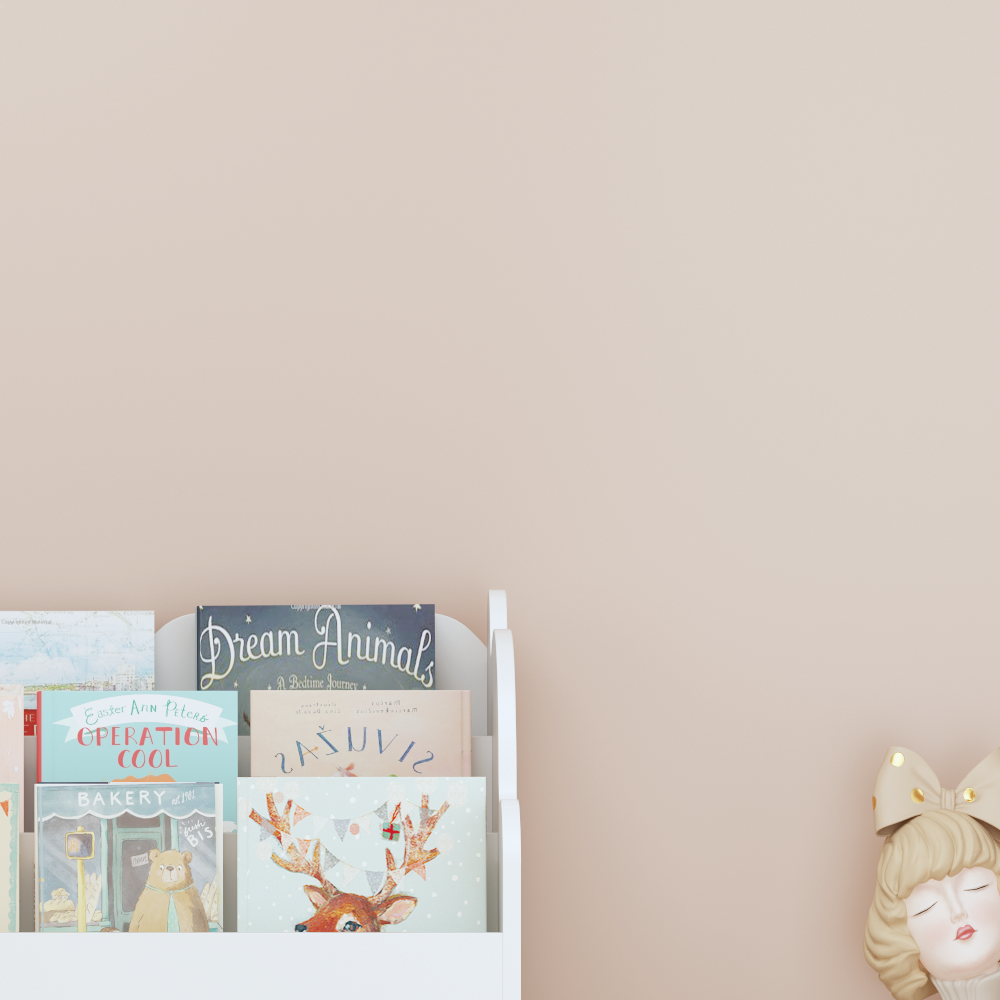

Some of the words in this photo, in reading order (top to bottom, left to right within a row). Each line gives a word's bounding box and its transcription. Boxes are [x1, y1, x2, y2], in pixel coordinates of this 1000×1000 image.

[199, 615, 305, 690] Dream
[312, 604, 435, 688] Animals
[277, 676, 286, 690] A
[288, 674, 324, 690] Bedtime
[327, 673, 359, 690] Journey
[84, 705, 126, 726] Easter
[76, 726, 218, 746] OPERATION
[118, 748, 178, 768] COOL
[78, 789, 166, 807] BAKERY
[184, 820, 206, 838] fresh
[186, 826, 214, 848] BIS
